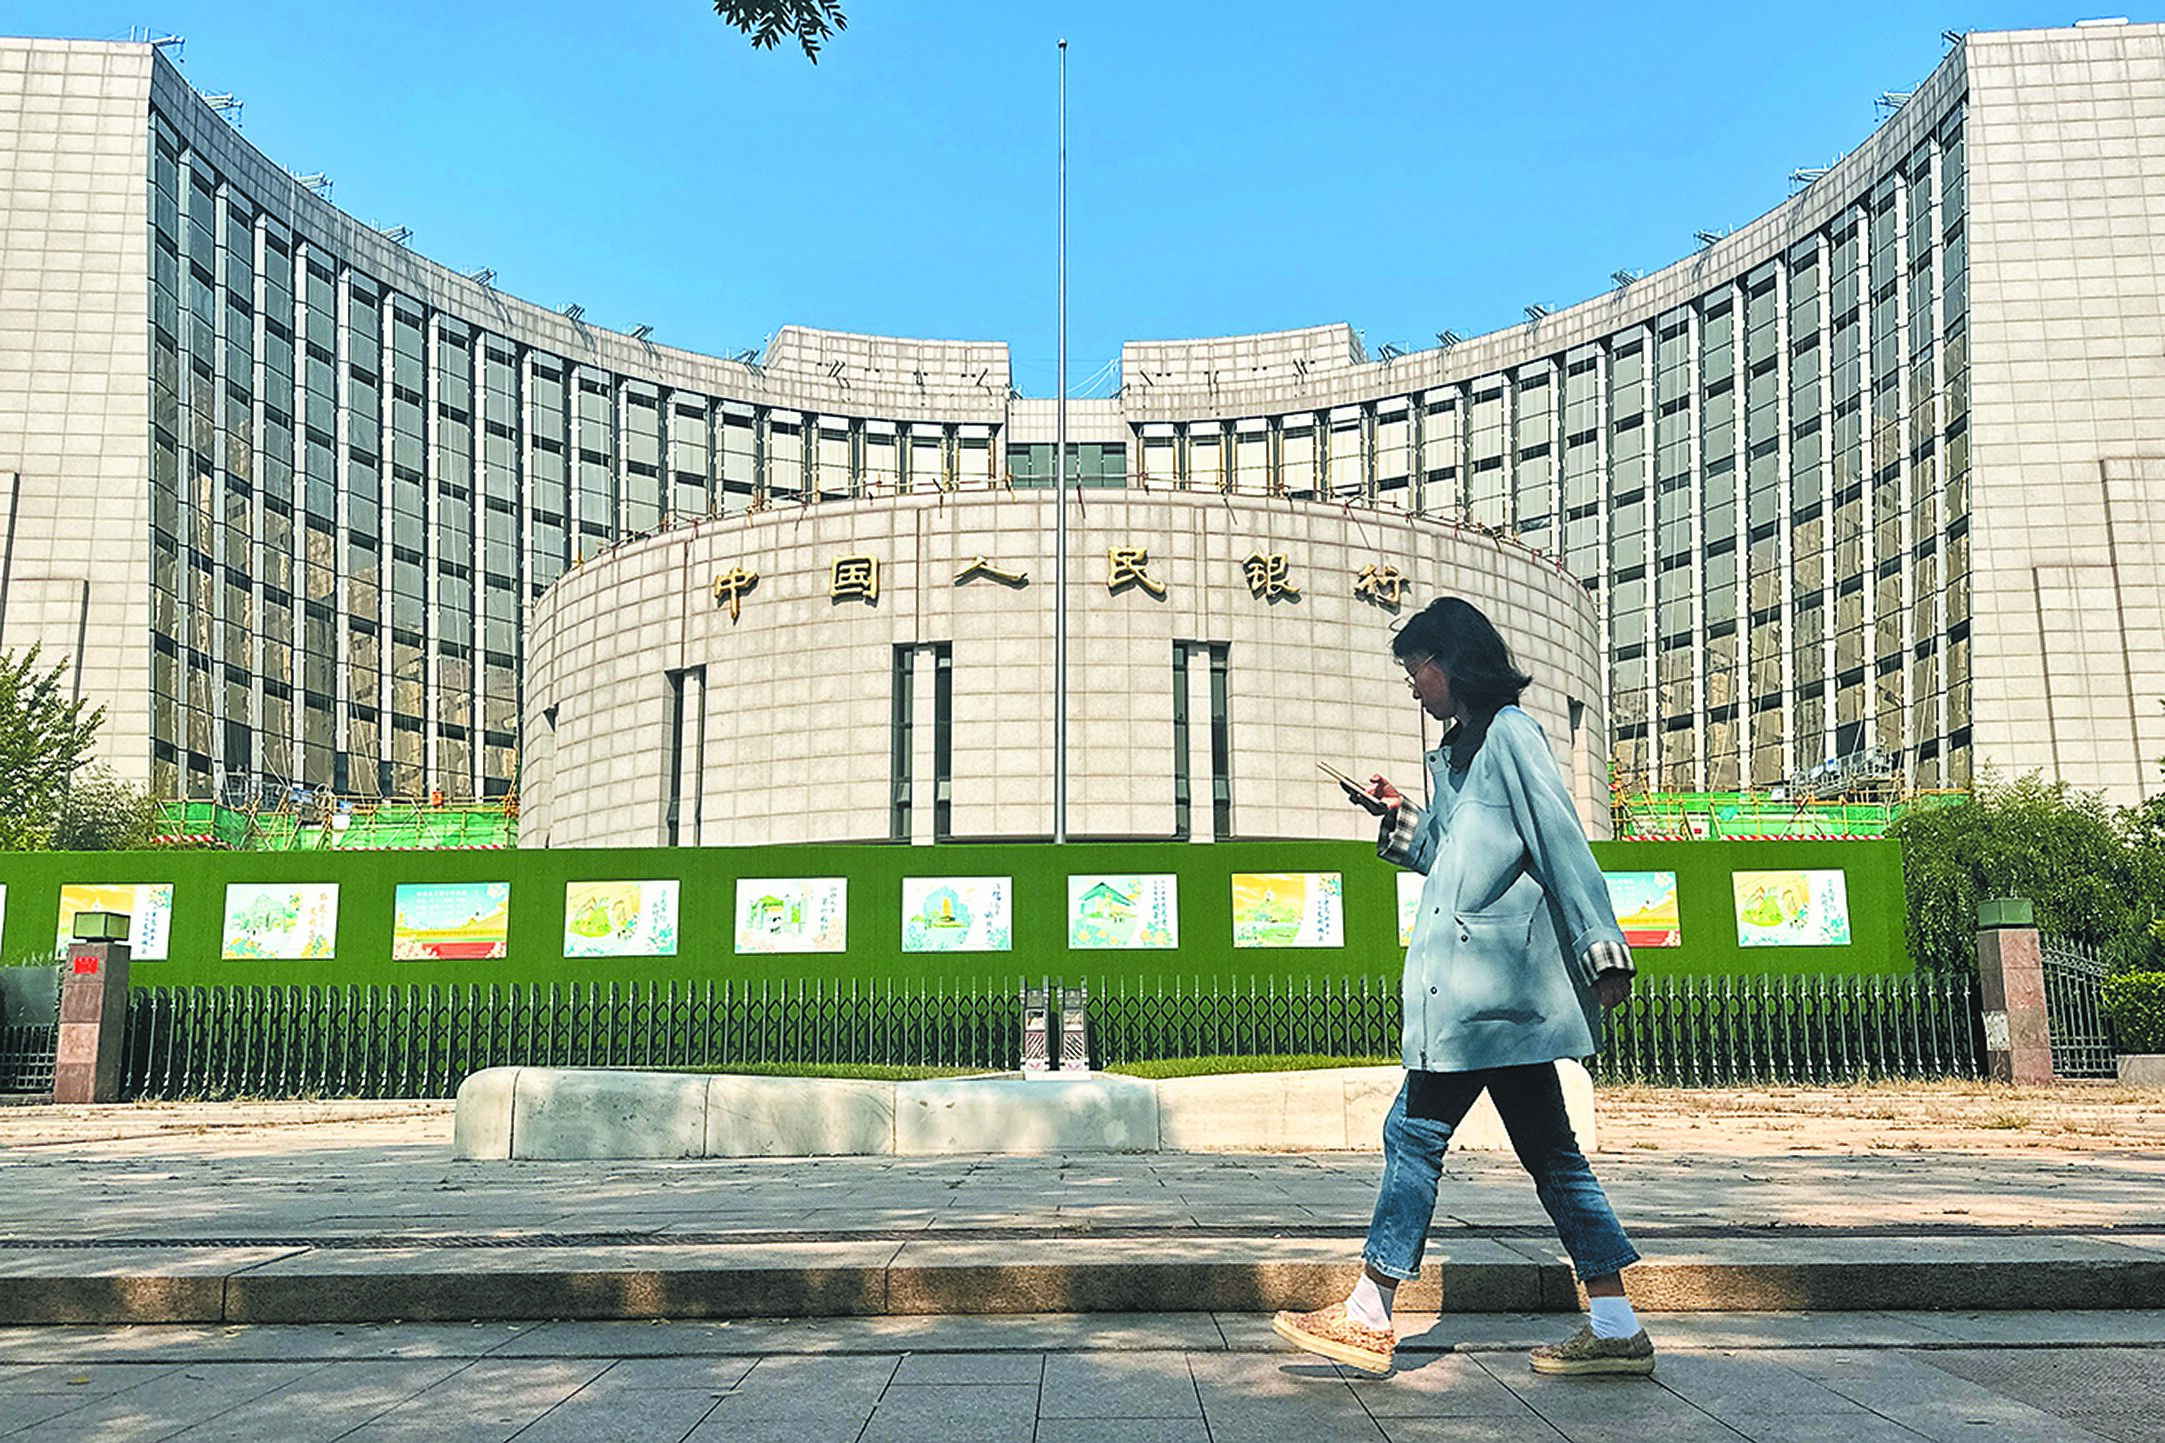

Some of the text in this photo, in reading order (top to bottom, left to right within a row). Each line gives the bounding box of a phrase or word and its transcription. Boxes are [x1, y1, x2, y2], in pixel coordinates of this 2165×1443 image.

[714, 546, 1410, 622] 中国人民银行
